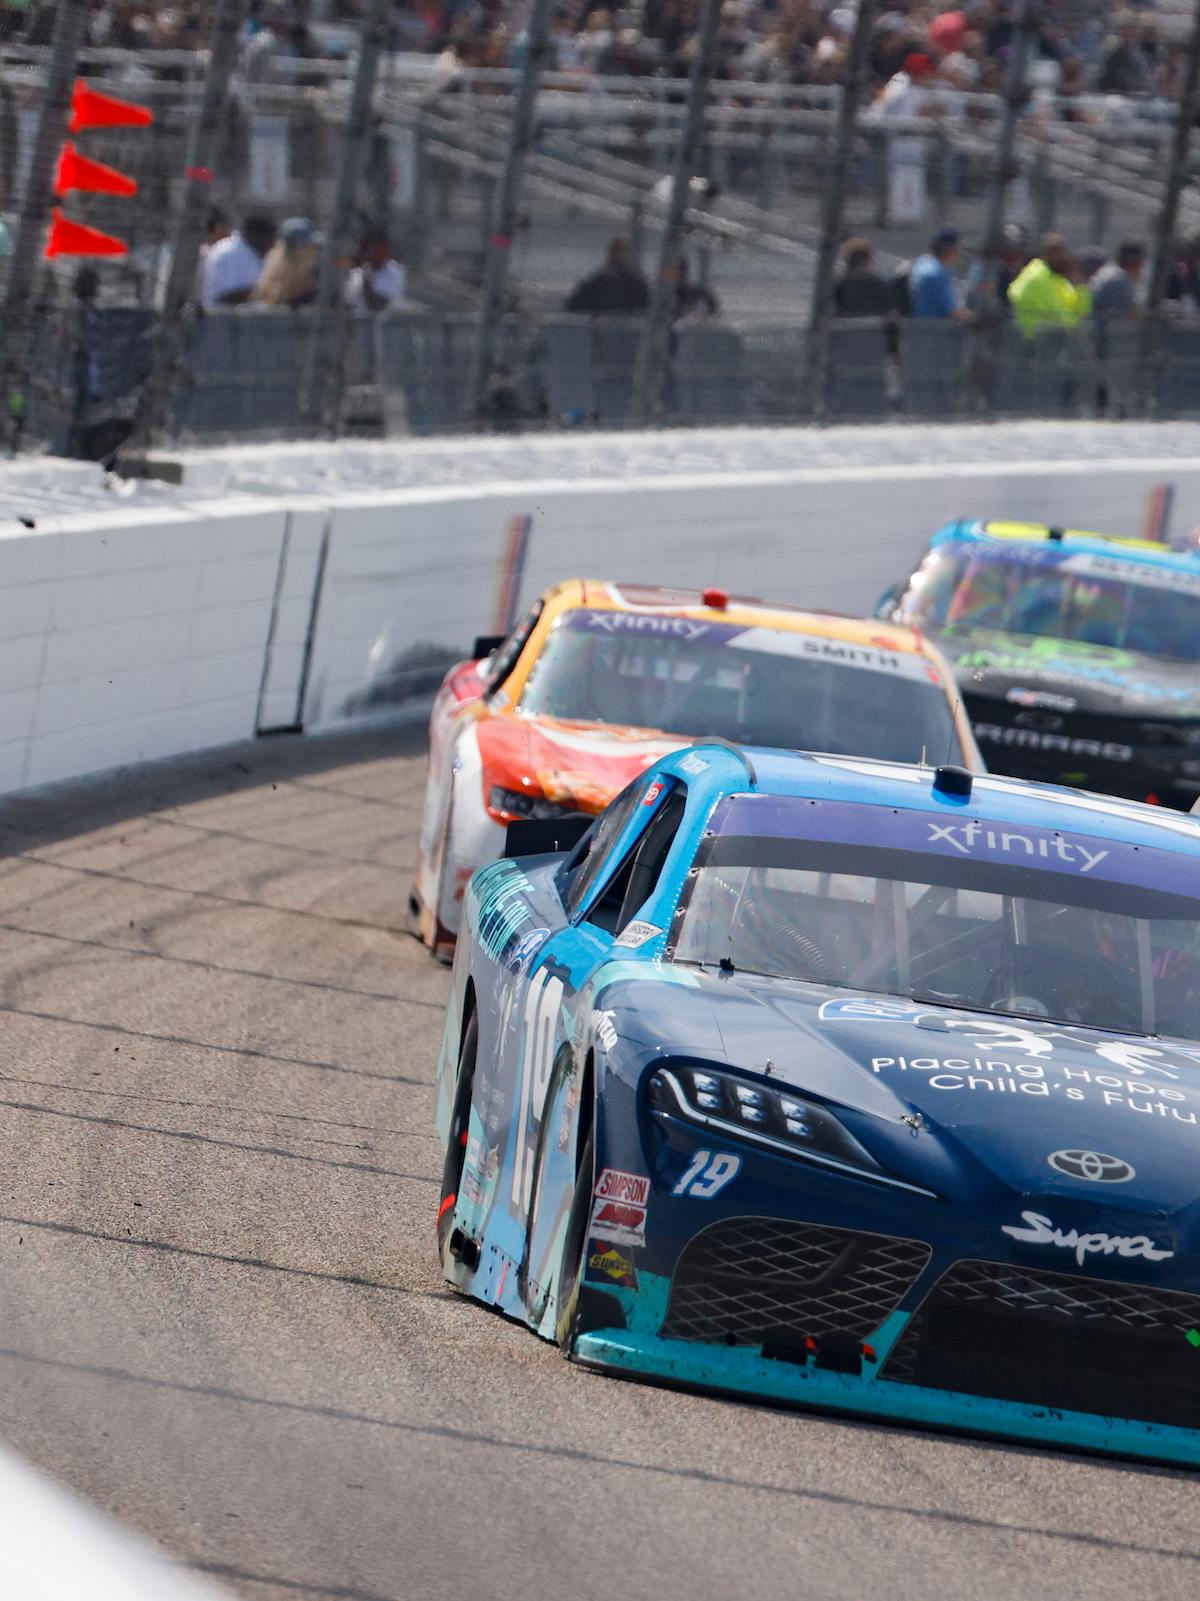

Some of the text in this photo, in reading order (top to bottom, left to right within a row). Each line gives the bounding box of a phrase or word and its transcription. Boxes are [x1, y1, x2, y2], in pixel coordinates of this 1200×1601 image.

[588, 611, 711, 640] xfinity
[802, 639, 899, 668] SMITH
[974, 722, 1134, 762] AMARO
[927, 822, 1109, 872] xfinity
[872, 1056, 1044, 1079] Placing
[1063, 1067, 1186, 1101] Hope
[929, 1073, 1085, 1101] Child's
[599, 1172, 647, 1203] SIMPSON
[672, 1149, 741, 1199] 19
[1001, 1210, 1175, 1266] Supra
[590, 1254, 633, 1275] SUNOCO
